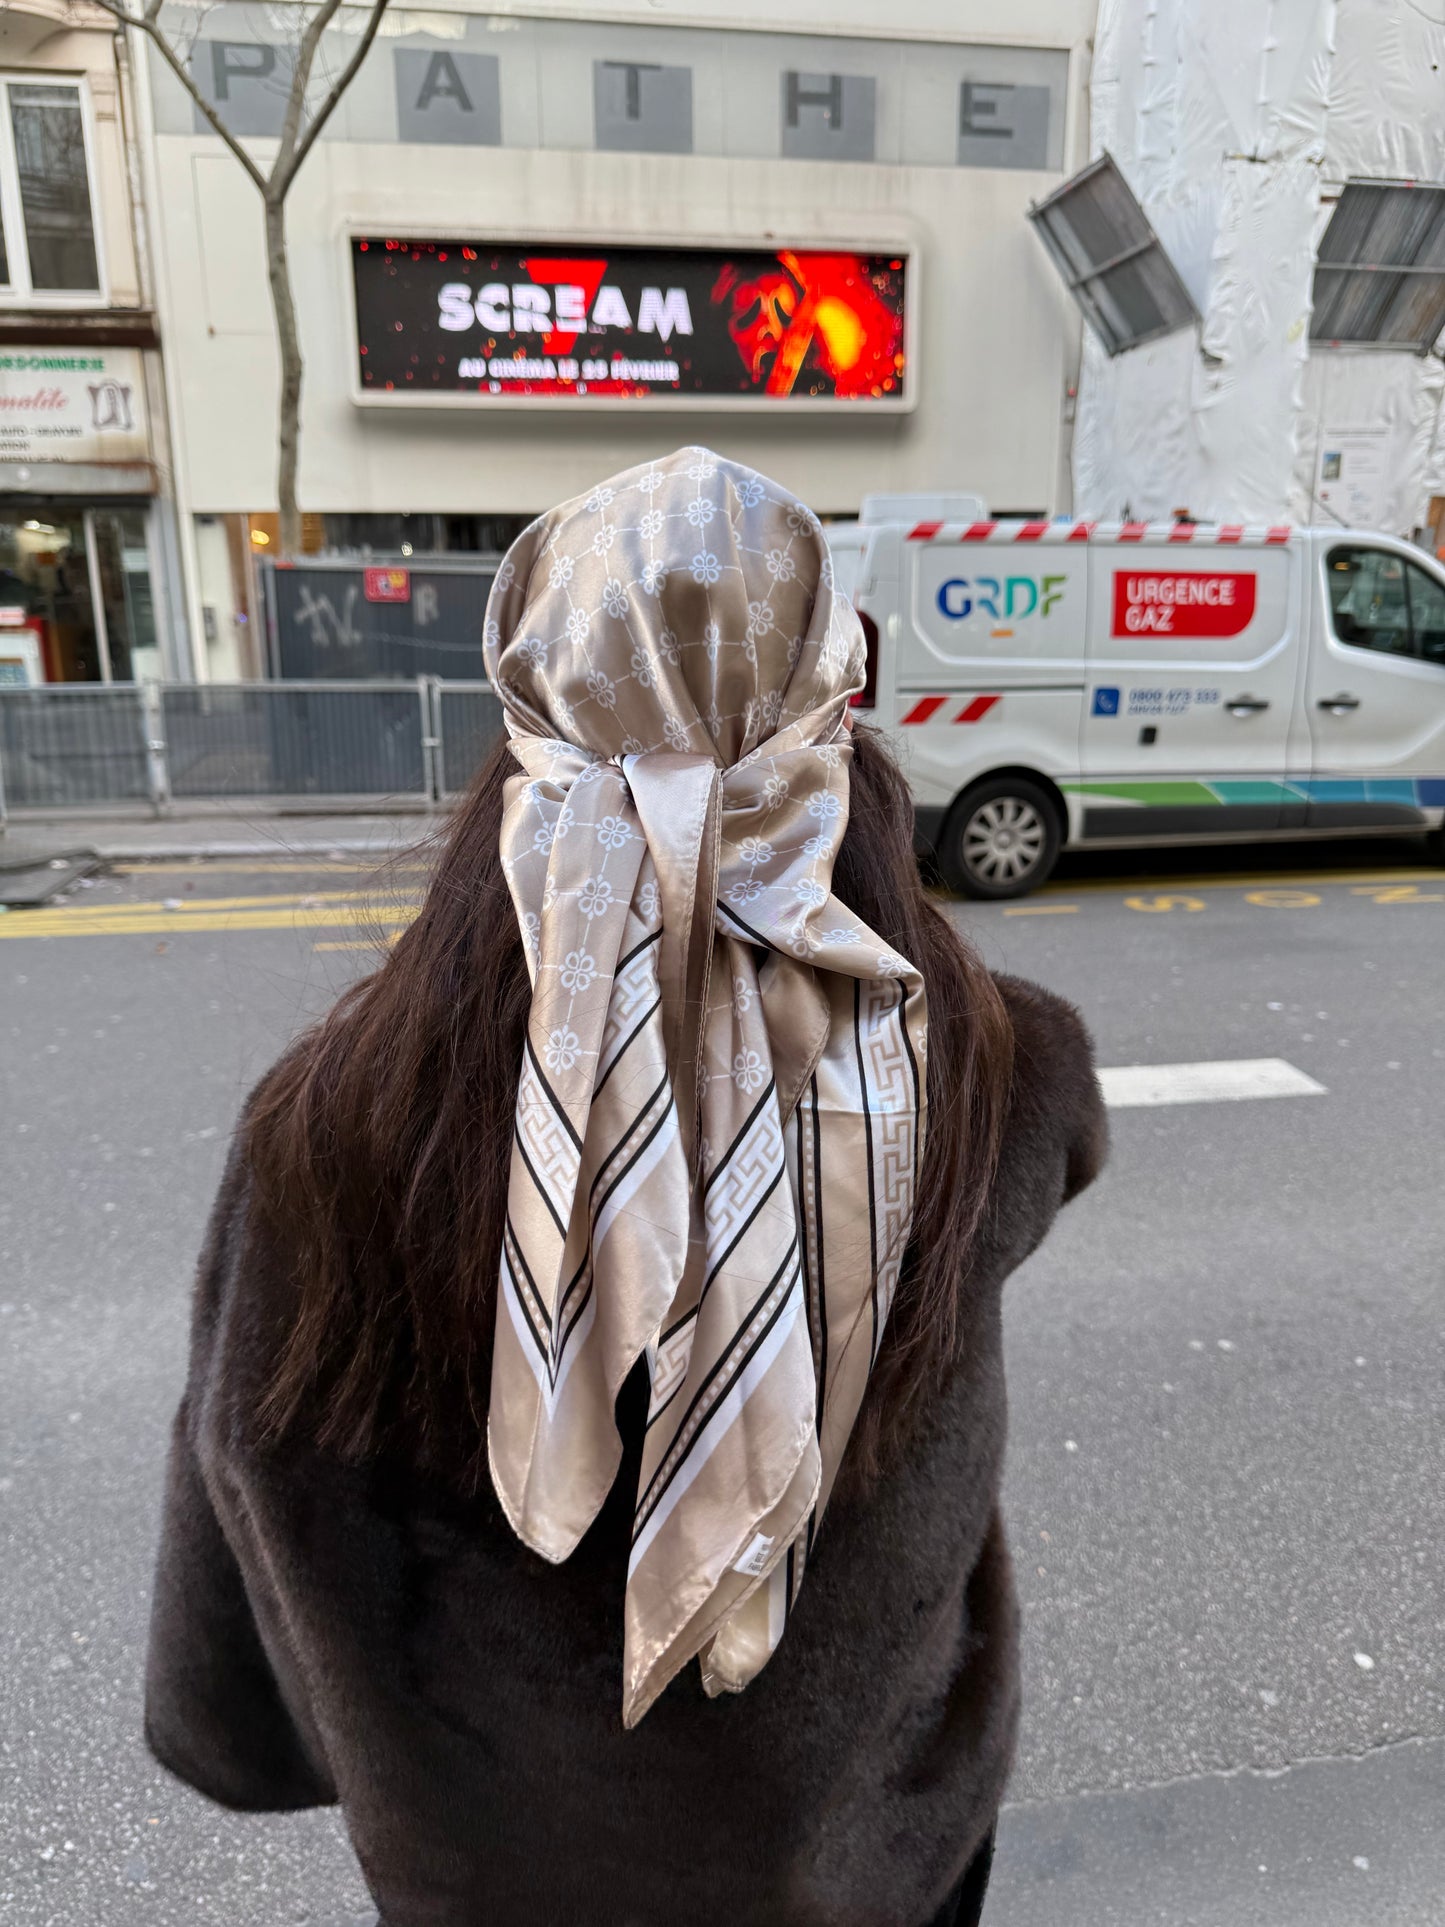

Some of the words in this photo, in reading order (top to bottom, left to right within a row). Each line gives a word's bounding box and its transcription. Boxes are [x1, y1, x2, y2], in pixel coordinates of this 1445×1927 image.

[438, 282, 694, 343] SCREAM
[936, 574, 1067, 620] GRDF
[1126, 577, 1236, 606] URGENCE
[1125, 605, 1176, 632] GAZ
